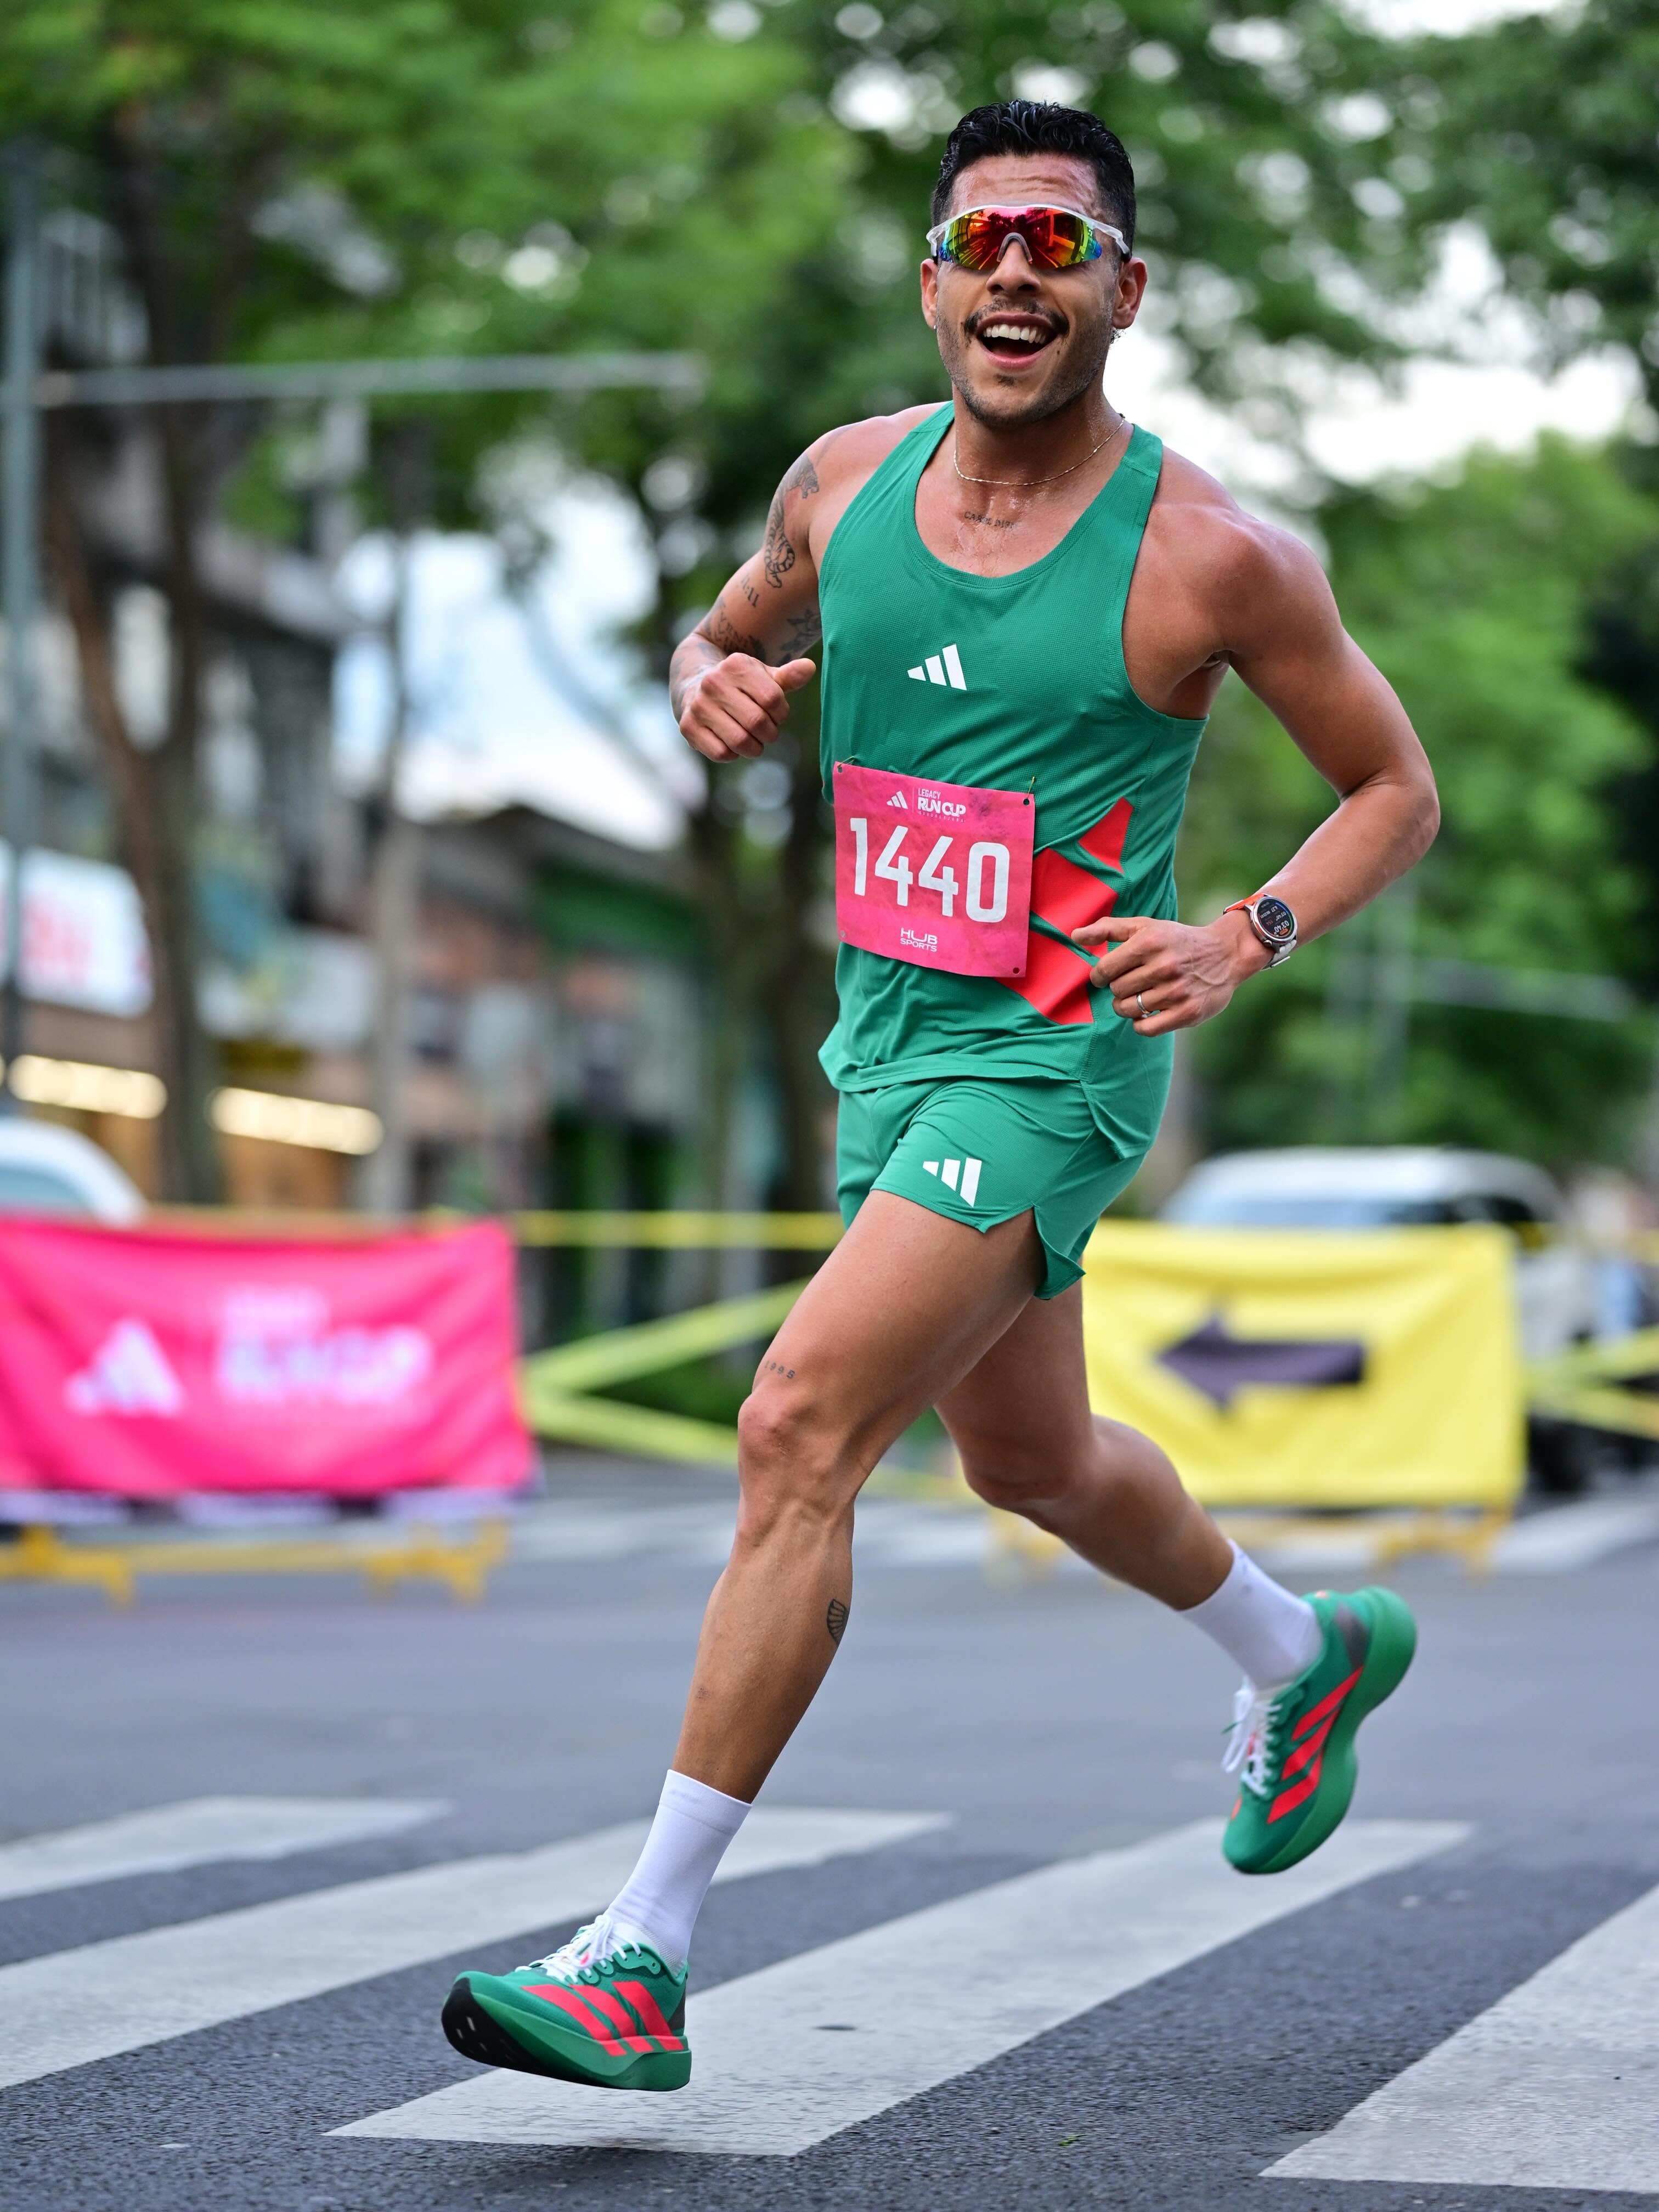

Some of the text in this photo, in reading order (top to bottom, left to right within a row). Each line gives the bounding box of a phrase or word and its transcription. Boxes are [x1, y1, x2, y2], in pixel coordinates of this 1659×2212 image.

[918, 787, 941, 800] LEGACY
[917, 797, 966, 817] RUN CUP
[850, 817, 1010, 923] 1440
[900, 927, 938, 945] HUB
[900, 938, 938, 952] SPORTS
[764, 1361, 795, 1378] 1995
